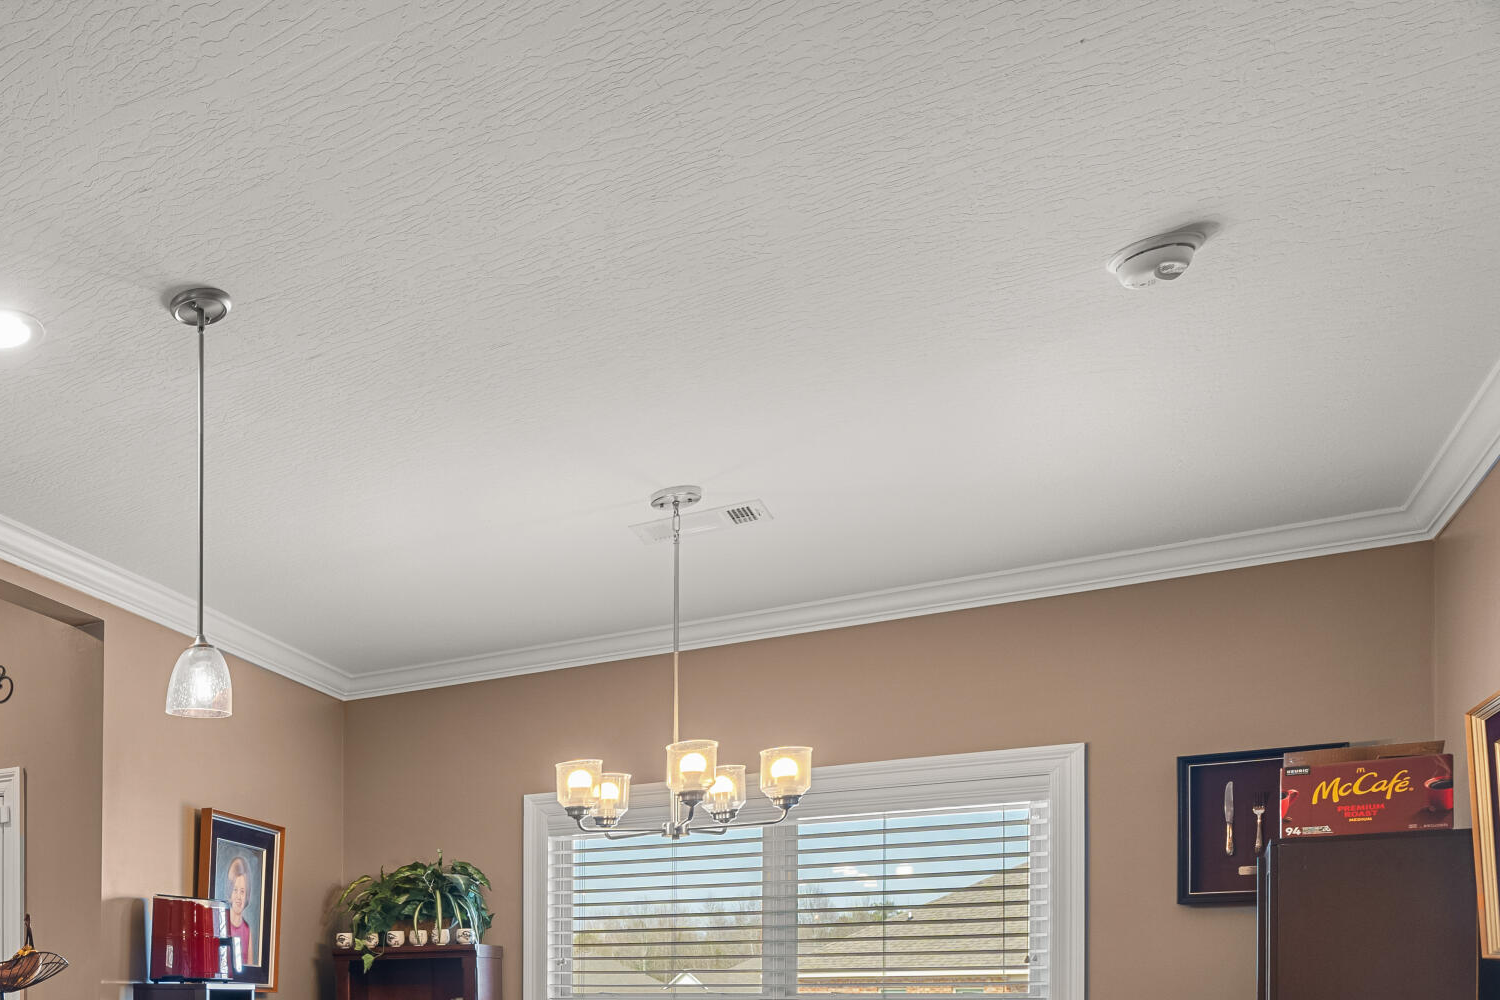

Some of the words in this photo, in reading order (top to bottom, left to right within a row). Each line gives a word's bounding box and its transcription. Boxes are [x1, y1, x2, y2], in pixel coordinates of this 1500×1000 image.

[1312, 769, 1411, 805] McCafé
[1337, 803, 1385, 812] PREMIUM
[1344, 810, 1378, 818] ROAST
[1285, 827, 1301, 836] 94
